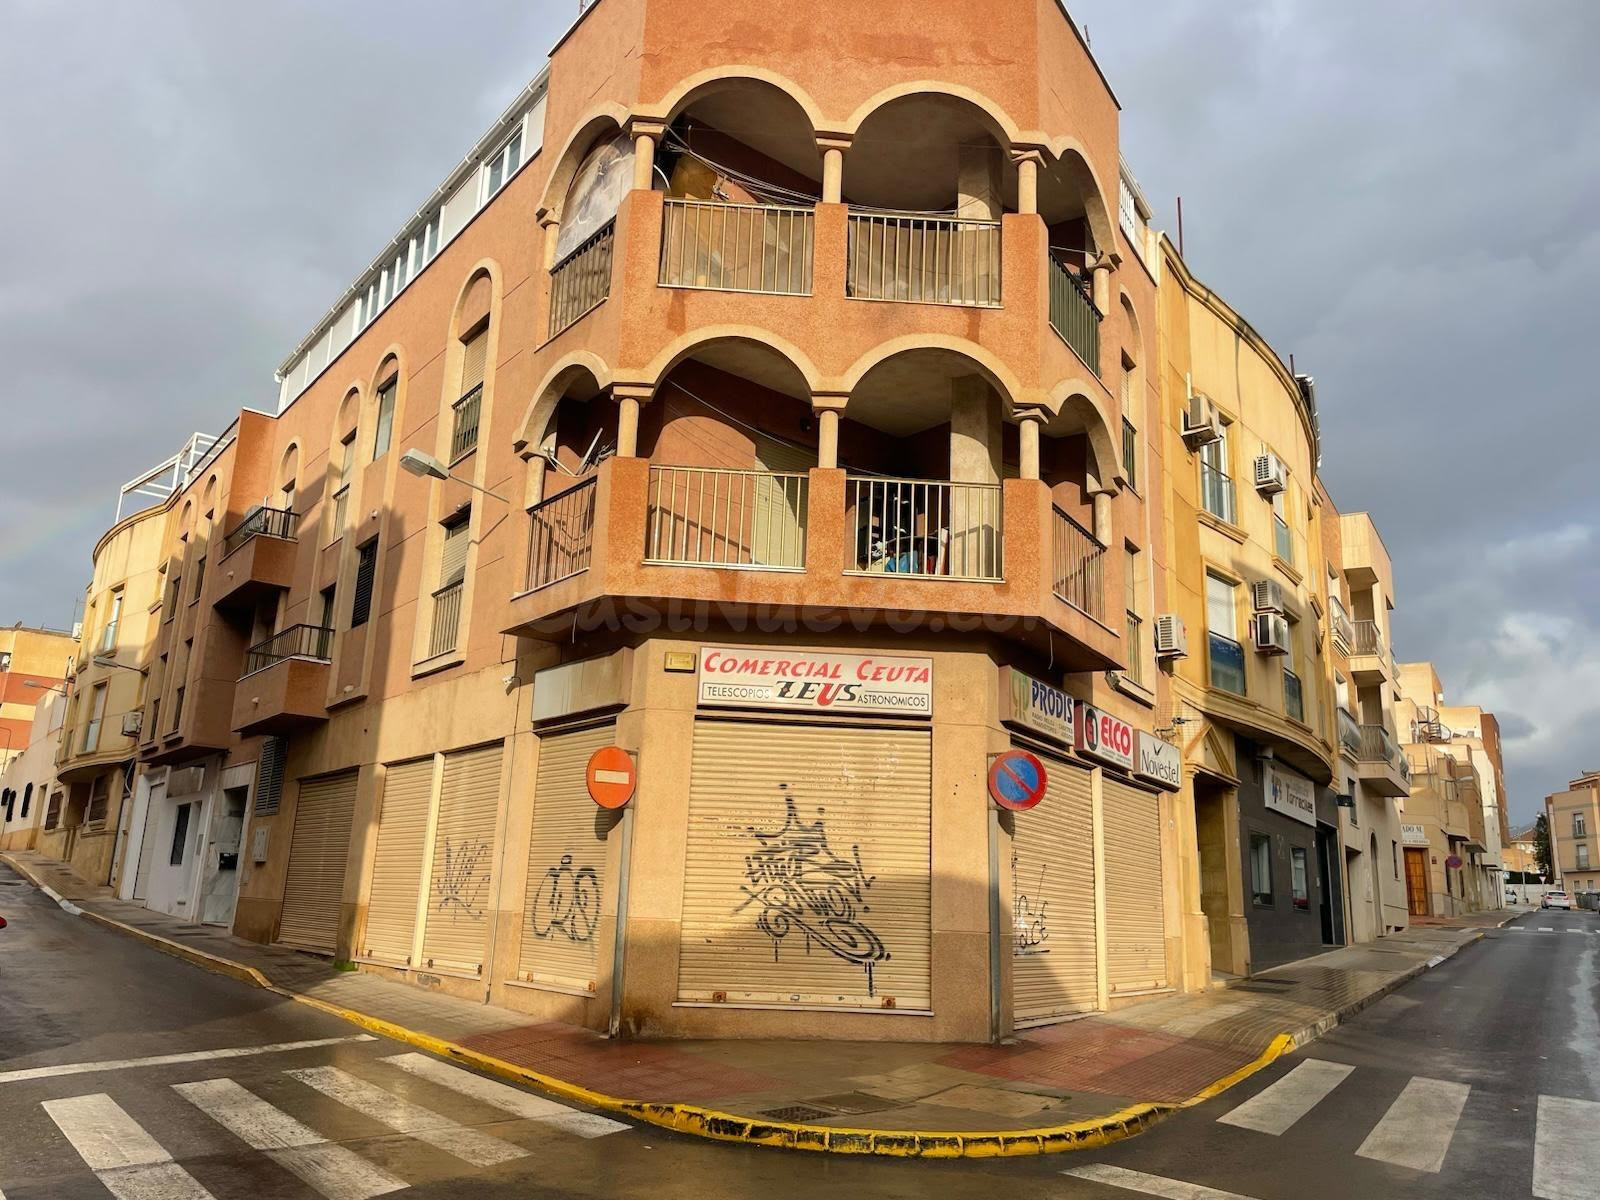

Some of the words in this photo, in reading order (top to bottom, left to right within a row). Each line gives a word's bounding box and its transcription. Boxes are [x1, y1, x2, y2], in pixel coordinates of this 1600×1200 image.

[704, 651, 842, 679] COMERCIAL
[856, 659, 930, 683] CEUTA
[707, 685, 770, 700] TELESCOPIOS
[775, 680, 862, 706] ZEUS
[857, 693, 927, 708] ASTRONOMICOS
[1032, 680, 1073, 724] PRODIS
[1141, 749, 1180, 784] Novestel
